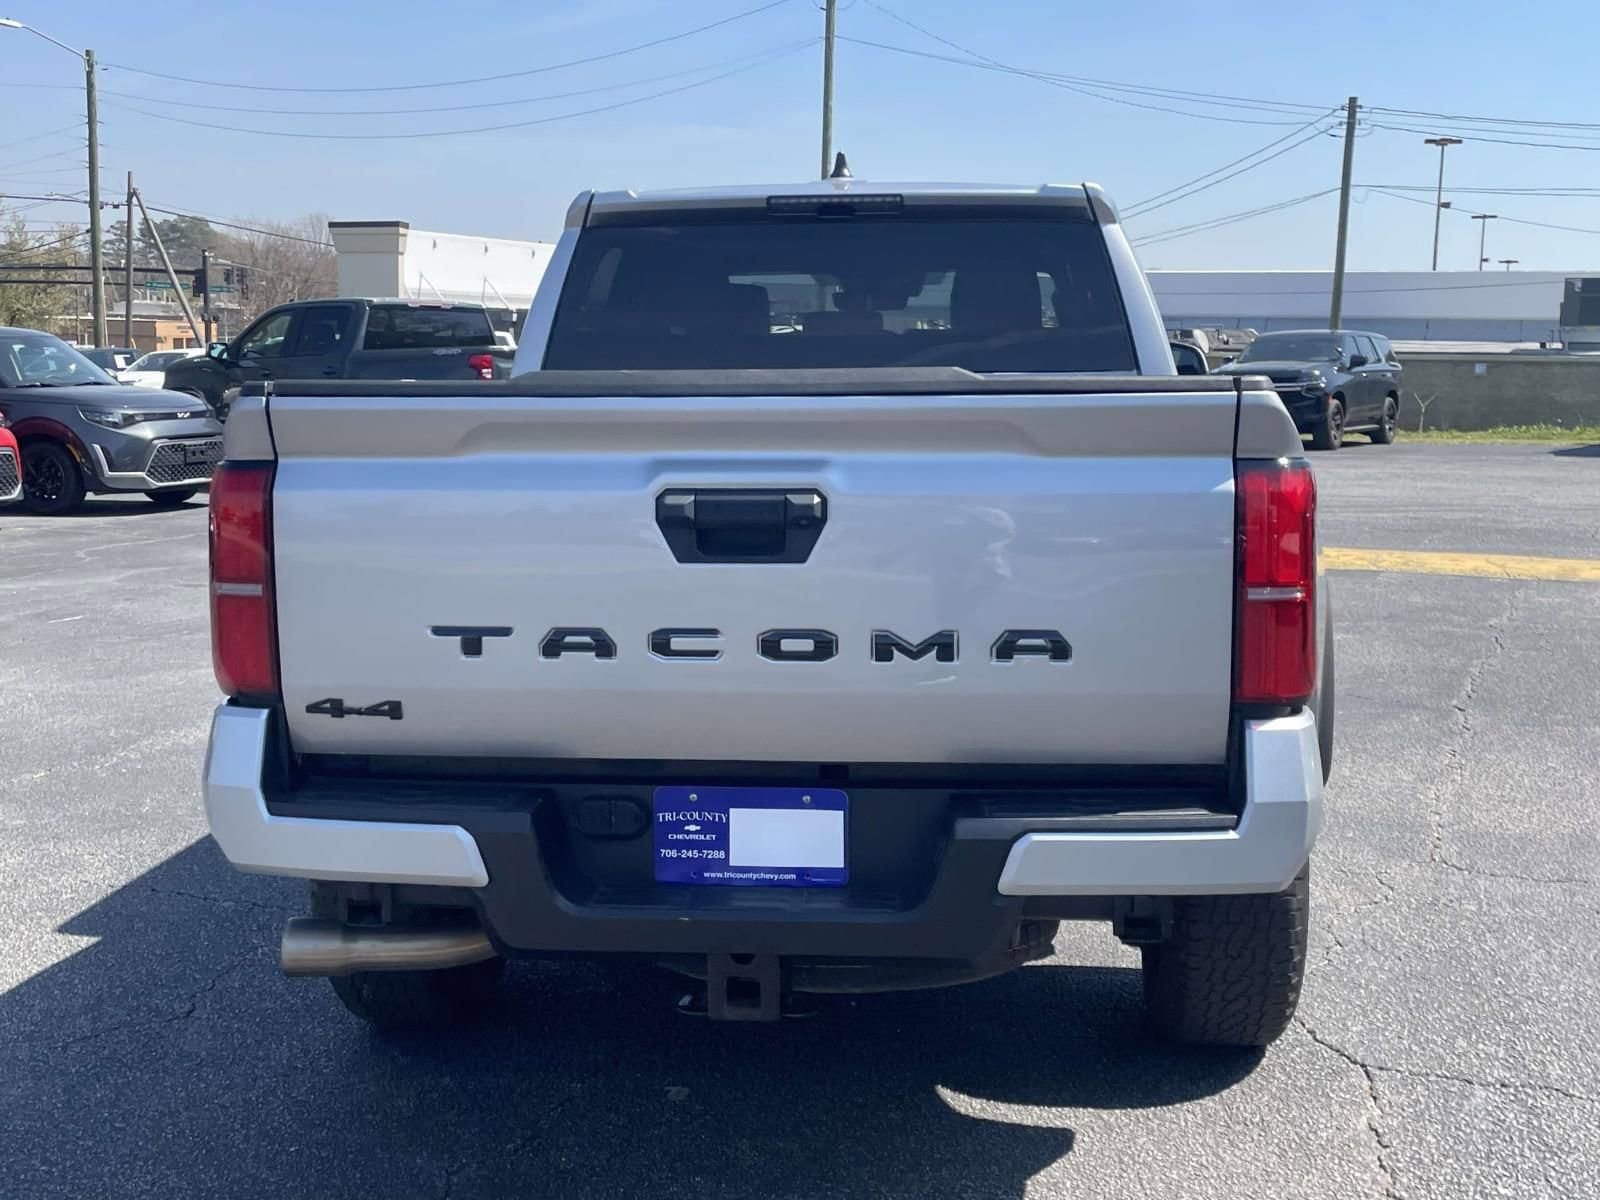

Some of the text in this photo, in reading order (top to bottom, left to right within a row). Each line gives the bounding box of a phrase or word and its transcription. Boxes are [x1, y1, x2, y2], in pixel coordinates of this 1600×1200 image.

[428, 625, 1073, 663] TACOMA
[657, 811, 727, 823] TRI-COUNTY
[703, 872, 796, 880] www.tricountychevy.com
